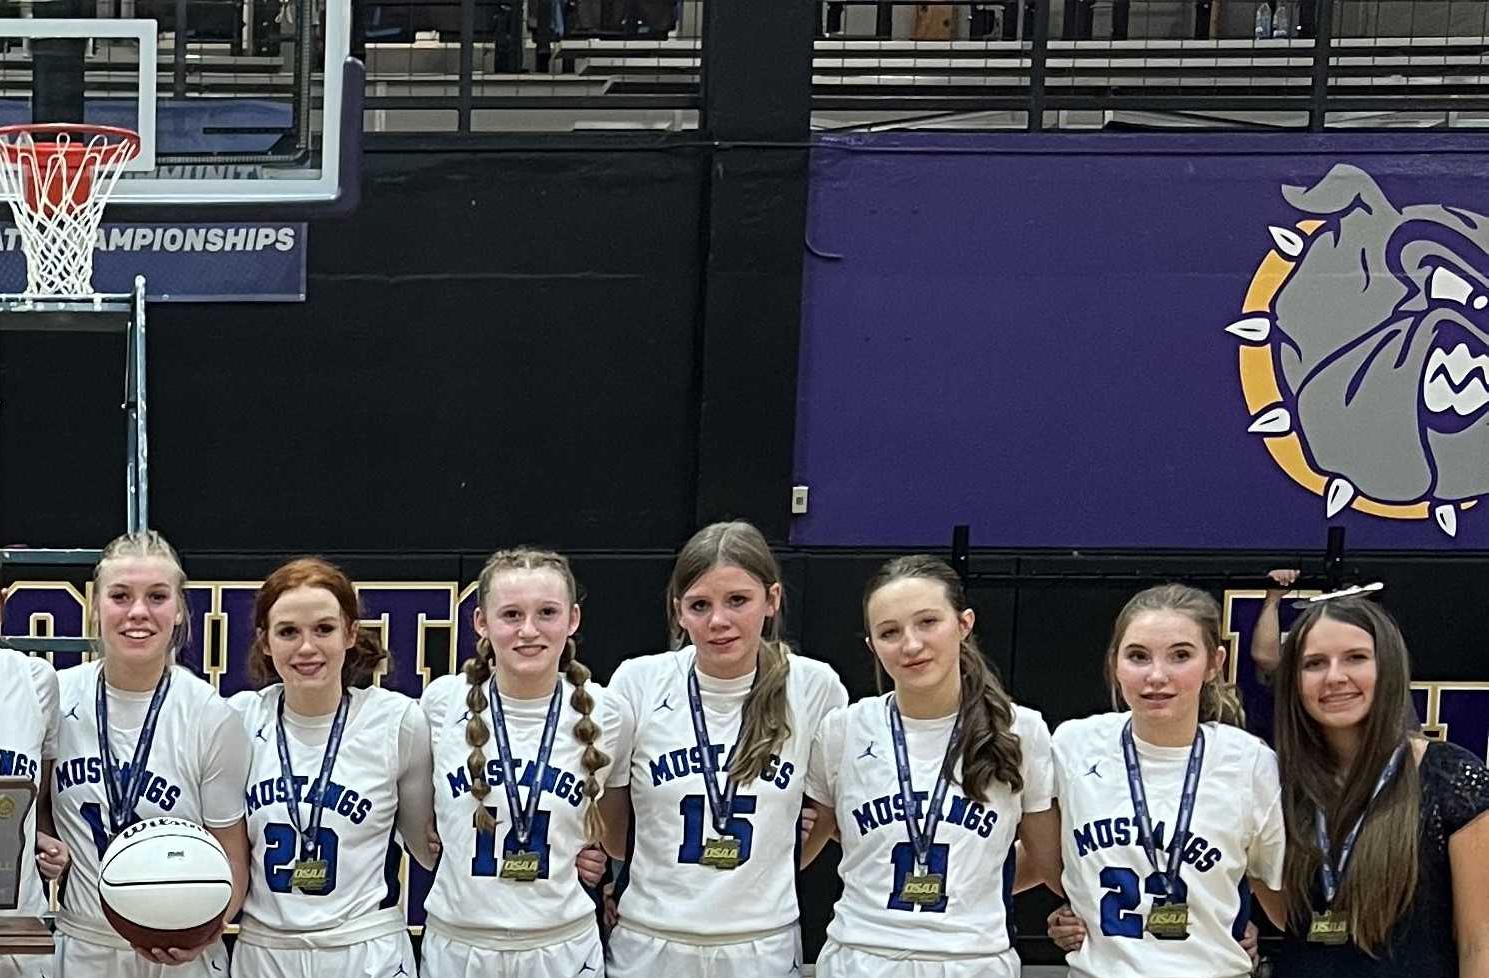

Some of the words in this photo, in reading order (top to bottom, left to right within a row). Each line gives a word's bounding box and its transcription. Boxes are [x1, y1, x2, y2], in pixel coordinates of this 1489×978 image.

[93, 227, 296, 251] AMPIONSHIPS
[649, 743, 795, 790] MUSTGS
[471, 806, 551, 880] 14
[678, 794, 757, 866] 15
[263, 822, 339, 897] 20
[504, 859, 539, 872] OSAA
[704, 847, 739, 859] OSAA
[294, 868, 327, 879] OSAA
[887, 841, 950, 913] 11
[904, 882, 940, 894] OSAA
[1099, 866, 1190, 941] 23
[1149, 911, 1187, 925] OSAA
